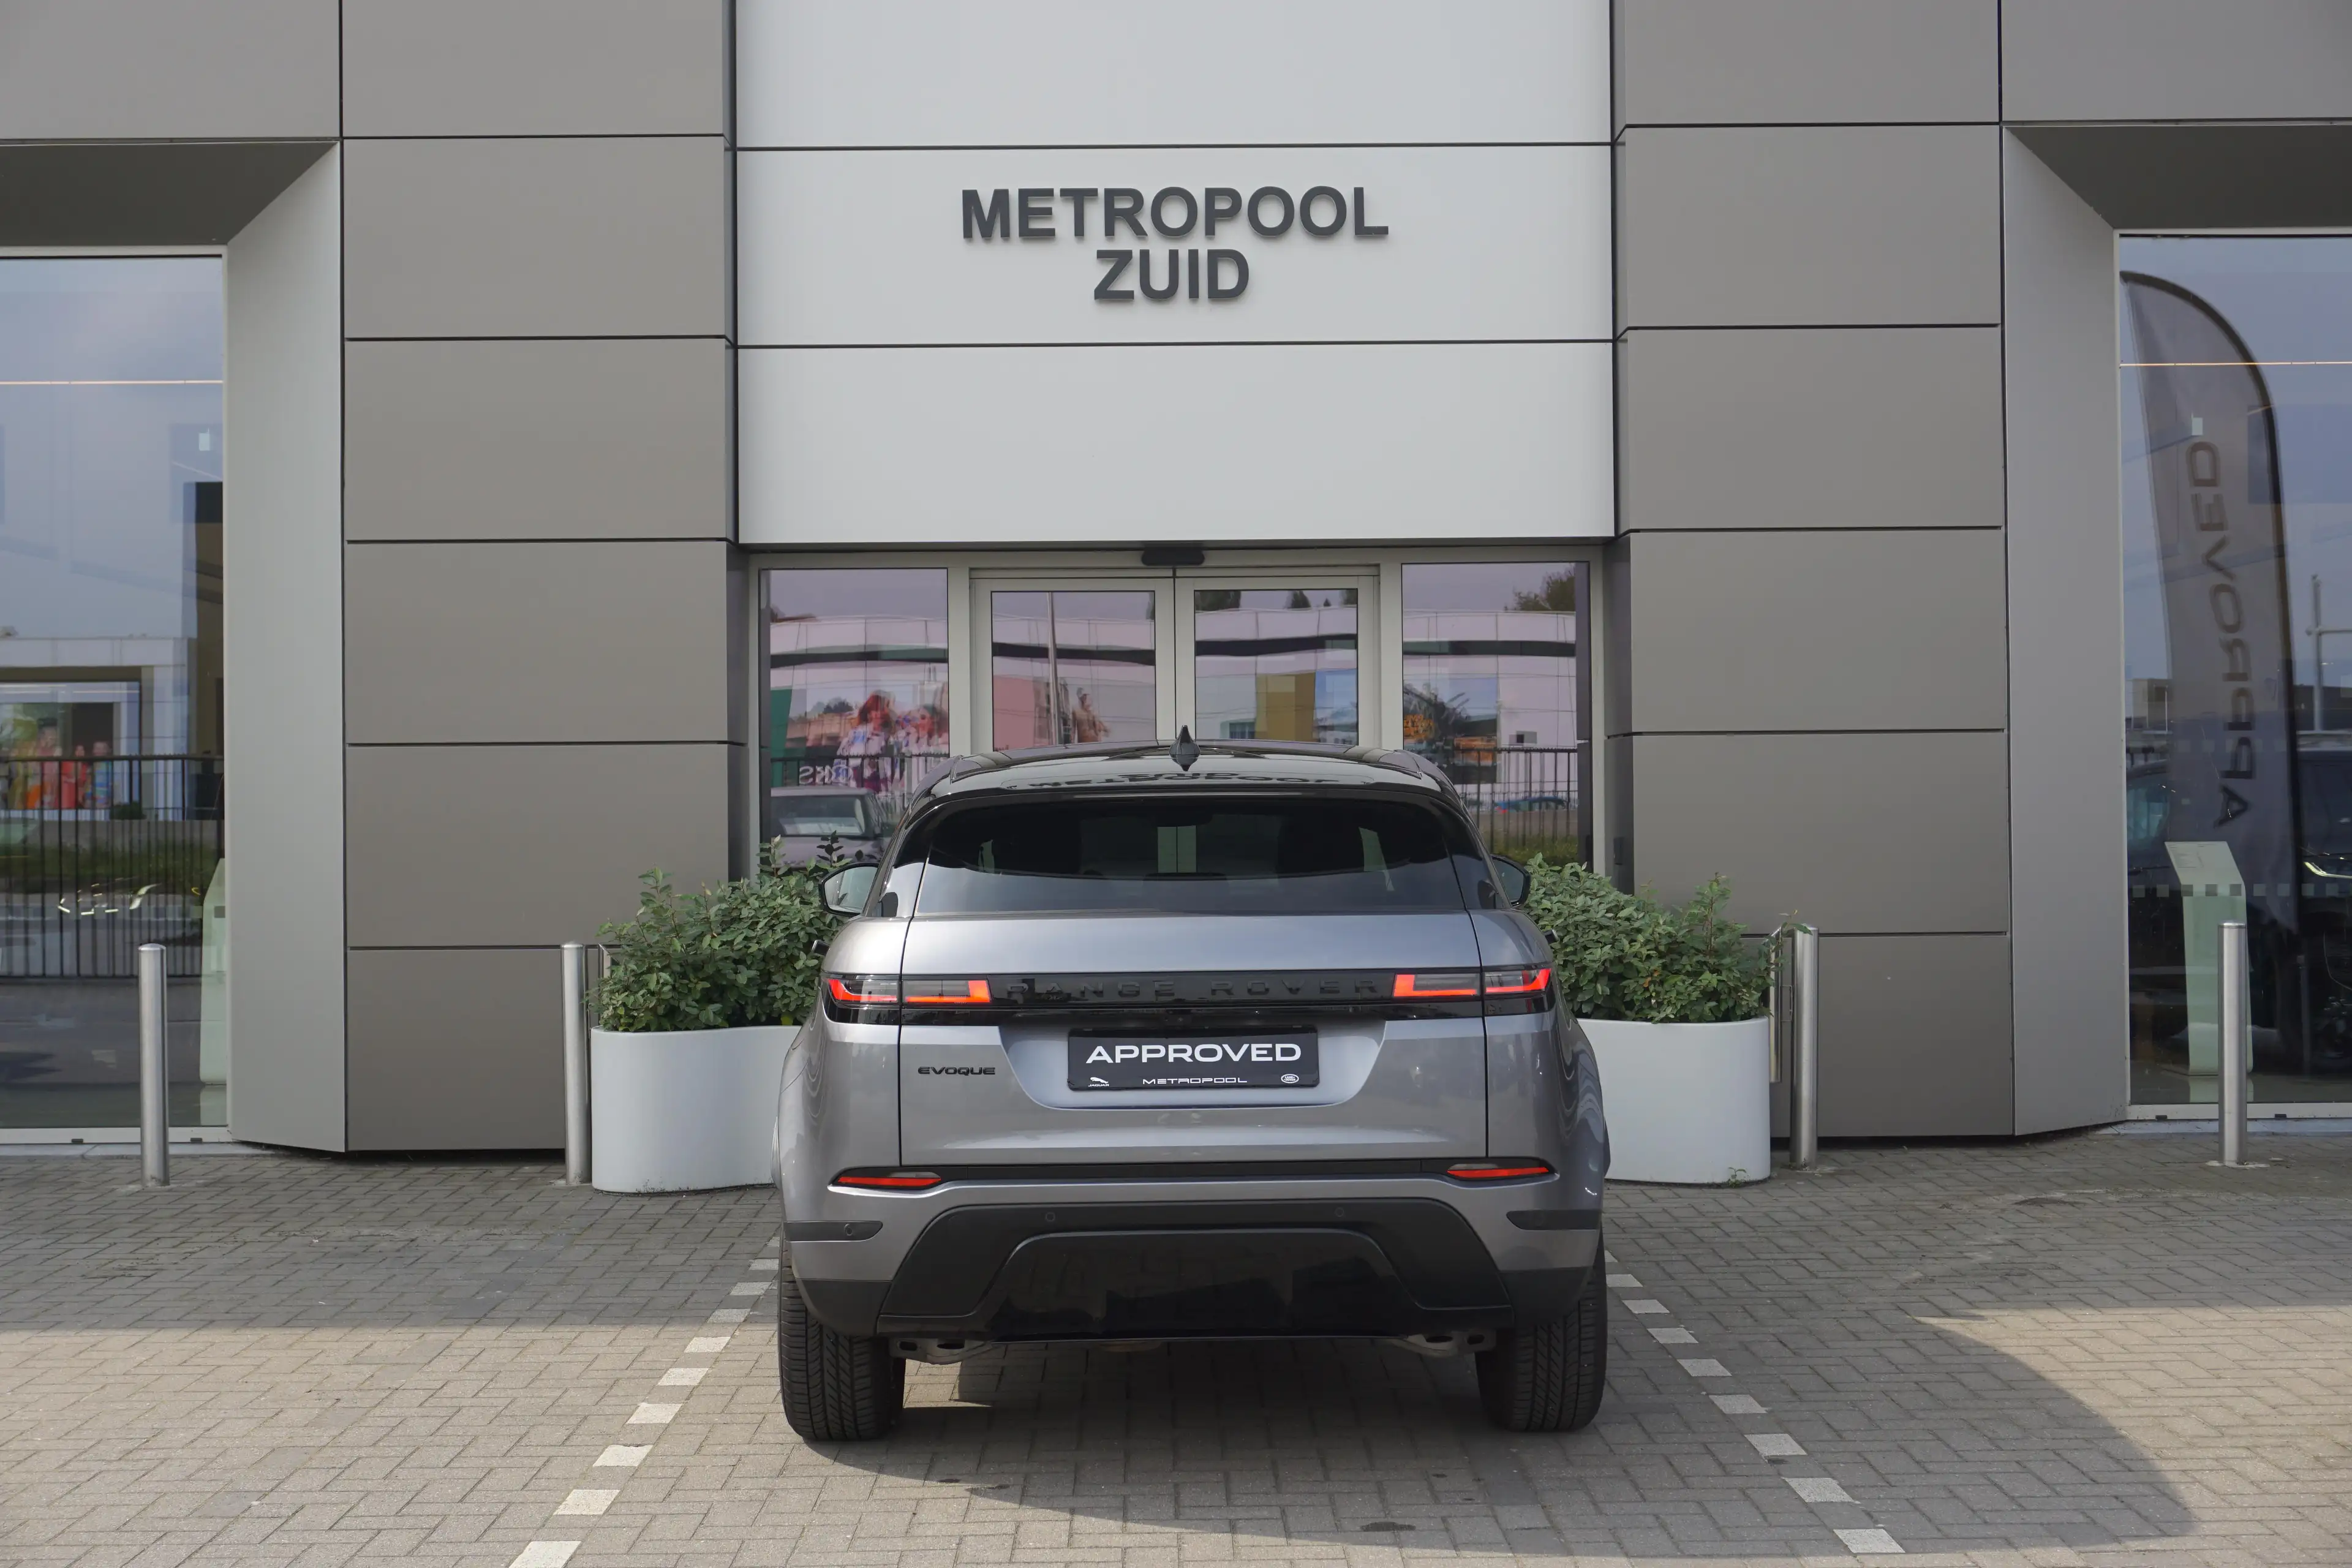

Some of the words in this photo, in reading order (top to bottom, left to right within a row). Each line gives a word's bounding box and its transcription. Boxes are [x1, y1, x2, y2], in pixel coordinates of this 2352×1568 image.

[962, 186, 1389, 239] METROPOOL
[1095, 249, 1249, 301] ZUID
[1007, 981, 1175, 999] RANGE
[1210, 979, 1378, 997] ROVER
[1086, 1044, 1302, 1063] APPROVED
[918, 1066, 996, 1076] EVOQUE
